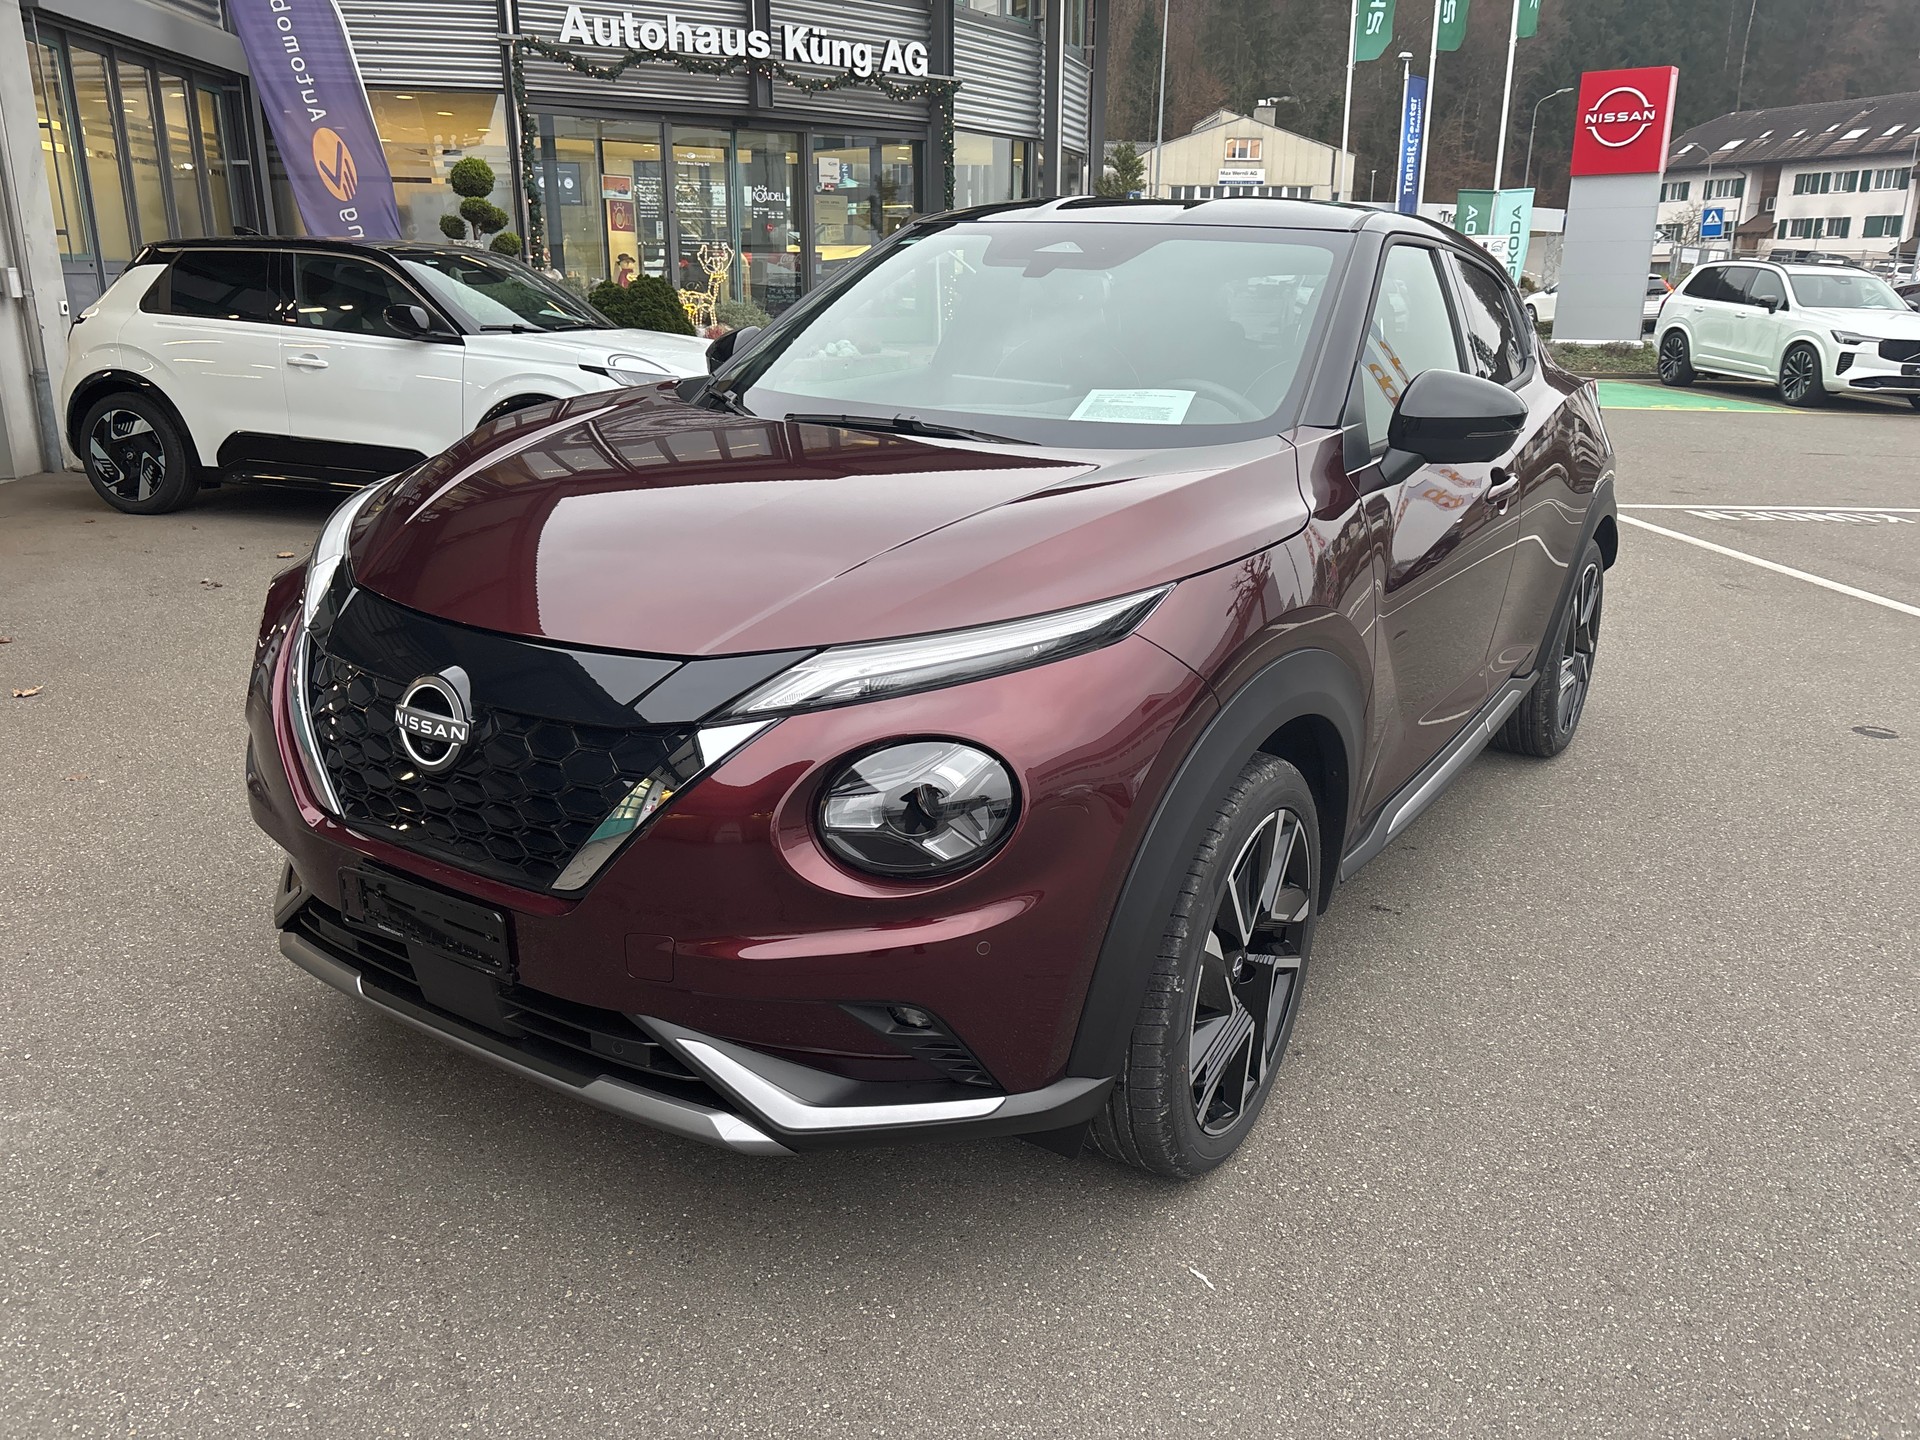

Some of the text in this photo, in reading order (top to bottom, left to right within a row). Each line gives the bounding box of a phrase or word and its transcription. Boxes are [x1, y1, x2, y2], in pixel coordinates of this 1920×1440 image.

[558, 5, 929, 78] Autohaus Küng AG
[1407, 97, 1418, 144] Center
[1584, 110, 1656, 124] NISSAN
[1403, 147, 1415, 195] Transit
[1684, 509, 1916, 523] KUNDEN
[395, 708, 467, 741] NISSAN
